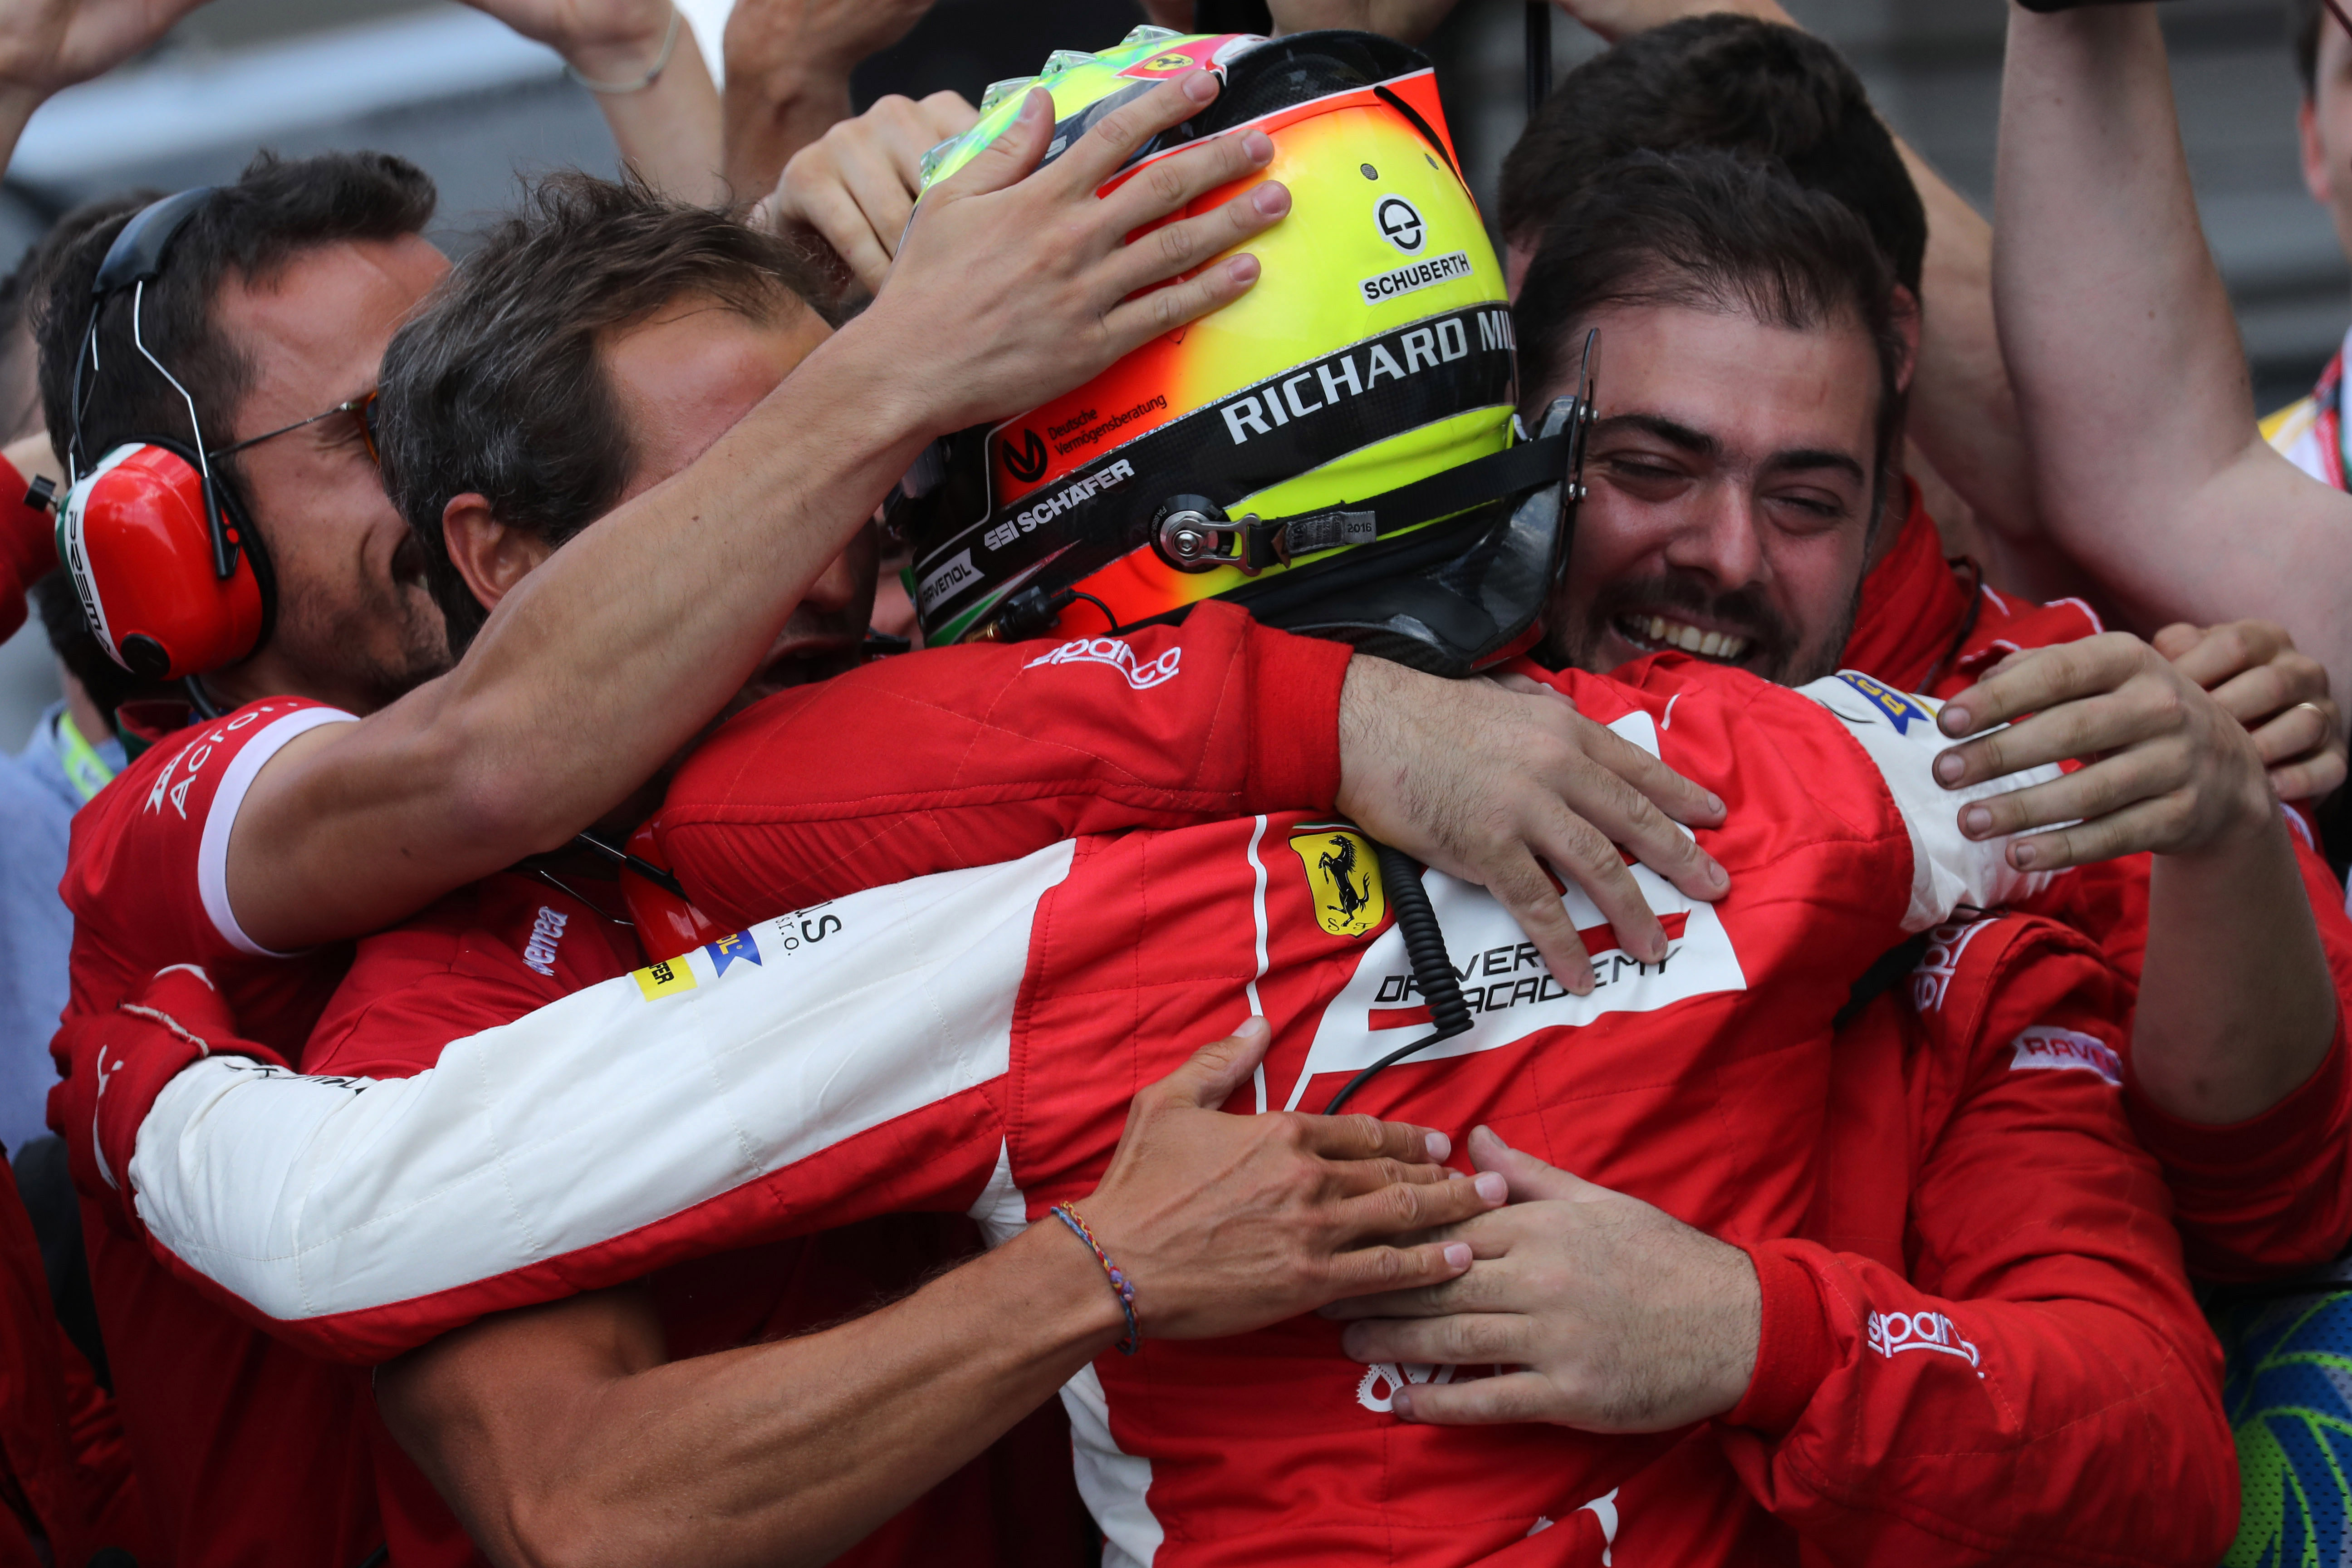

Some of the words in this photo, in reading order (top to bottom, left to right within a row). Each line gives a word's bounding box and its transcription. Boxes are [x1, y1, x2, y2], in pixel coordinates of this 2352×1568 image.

[1363, 253, 1470, 299] SCHUBERTH
[1220, 317, 1468, 445] RICHARD
[1048, 408, 1098, 441] Deutsche
[1054, 394, 1167, 456] Vermögensberatung
[984, 520, 1020, 552] SSI
[1017, 459, 1135, 533] SCHÄFER
[1347, 522, 1372, 534] 2016
[69, 511, 111, 653] PREMA
[922, 563, 972, 603] RAVENOL
[1024, 637, 1181, 690] sparco
[1374, 941, 1541, 1002] DRVER
